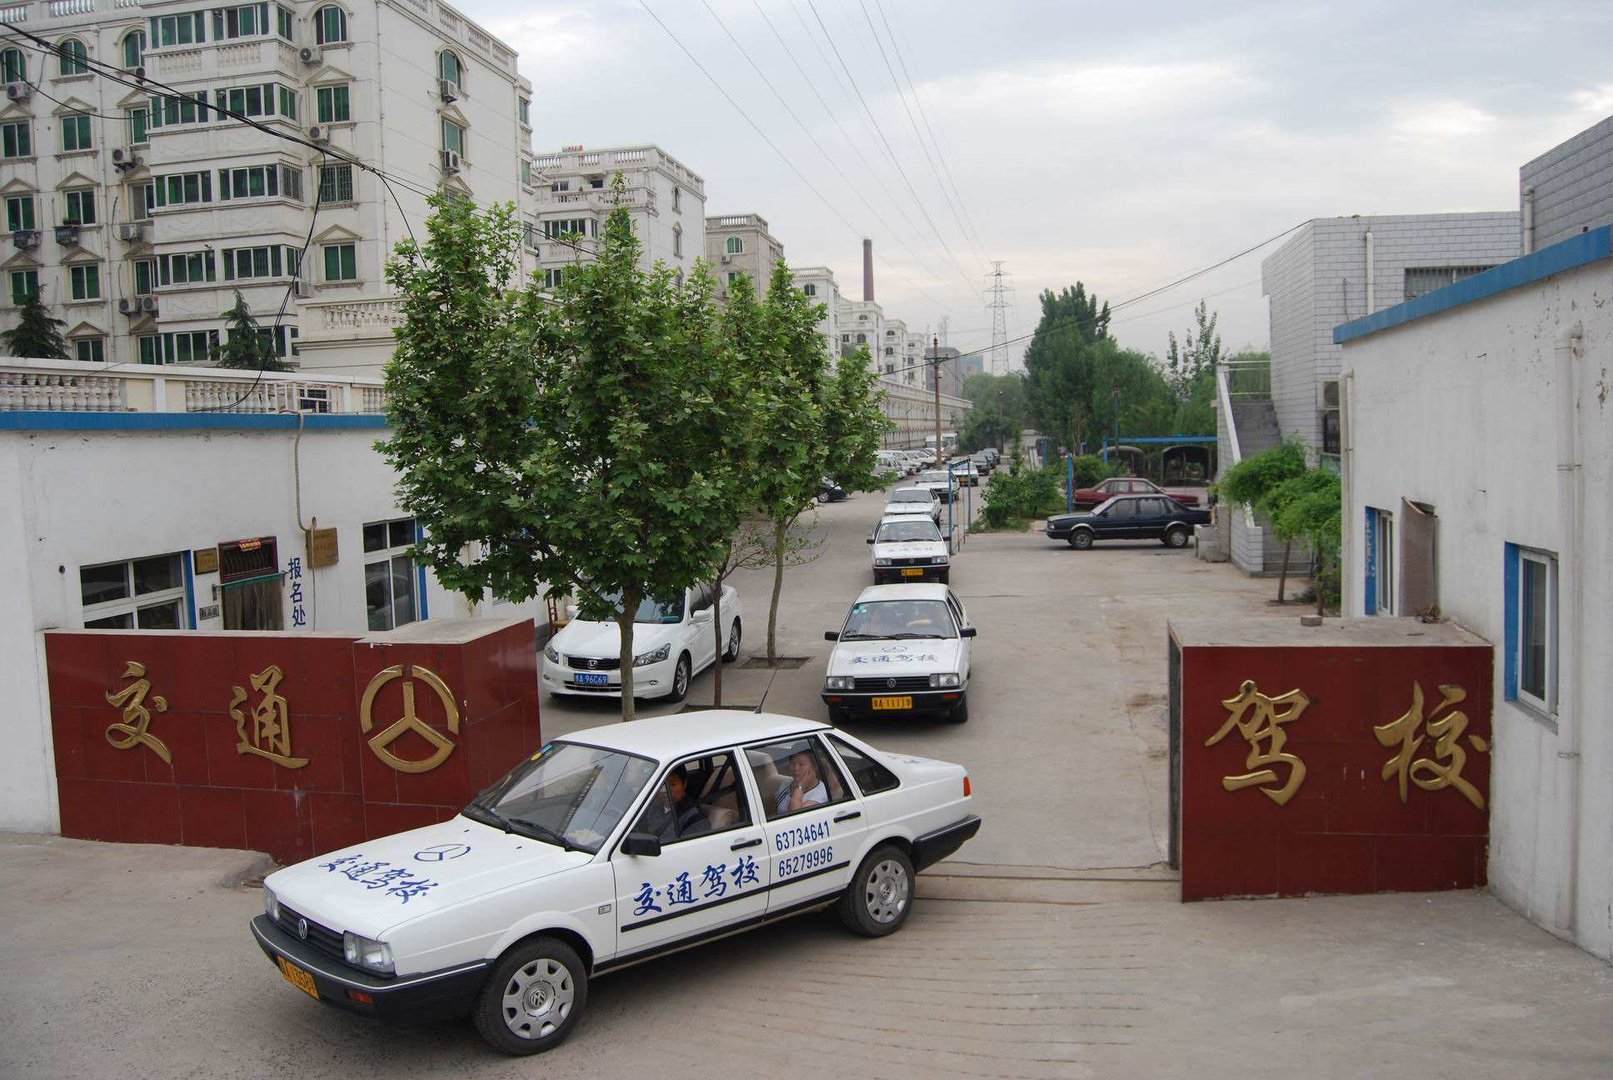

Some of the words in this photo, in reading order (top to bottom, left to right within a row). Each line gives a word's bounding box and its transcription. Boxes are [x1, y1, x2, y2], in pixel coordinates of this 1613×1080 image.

[287, 557, 306, 628] 报名处
[104, 660, 309, 770] 交通
[1204, 679, 1487, 810] 驾校
[775, 820, 831, 851] 63734641
[778, 847, 833, 878] 65279996
[319, 853, 439, 905] 交通驾校
[633, 855, 760, 917] 交通驾校
